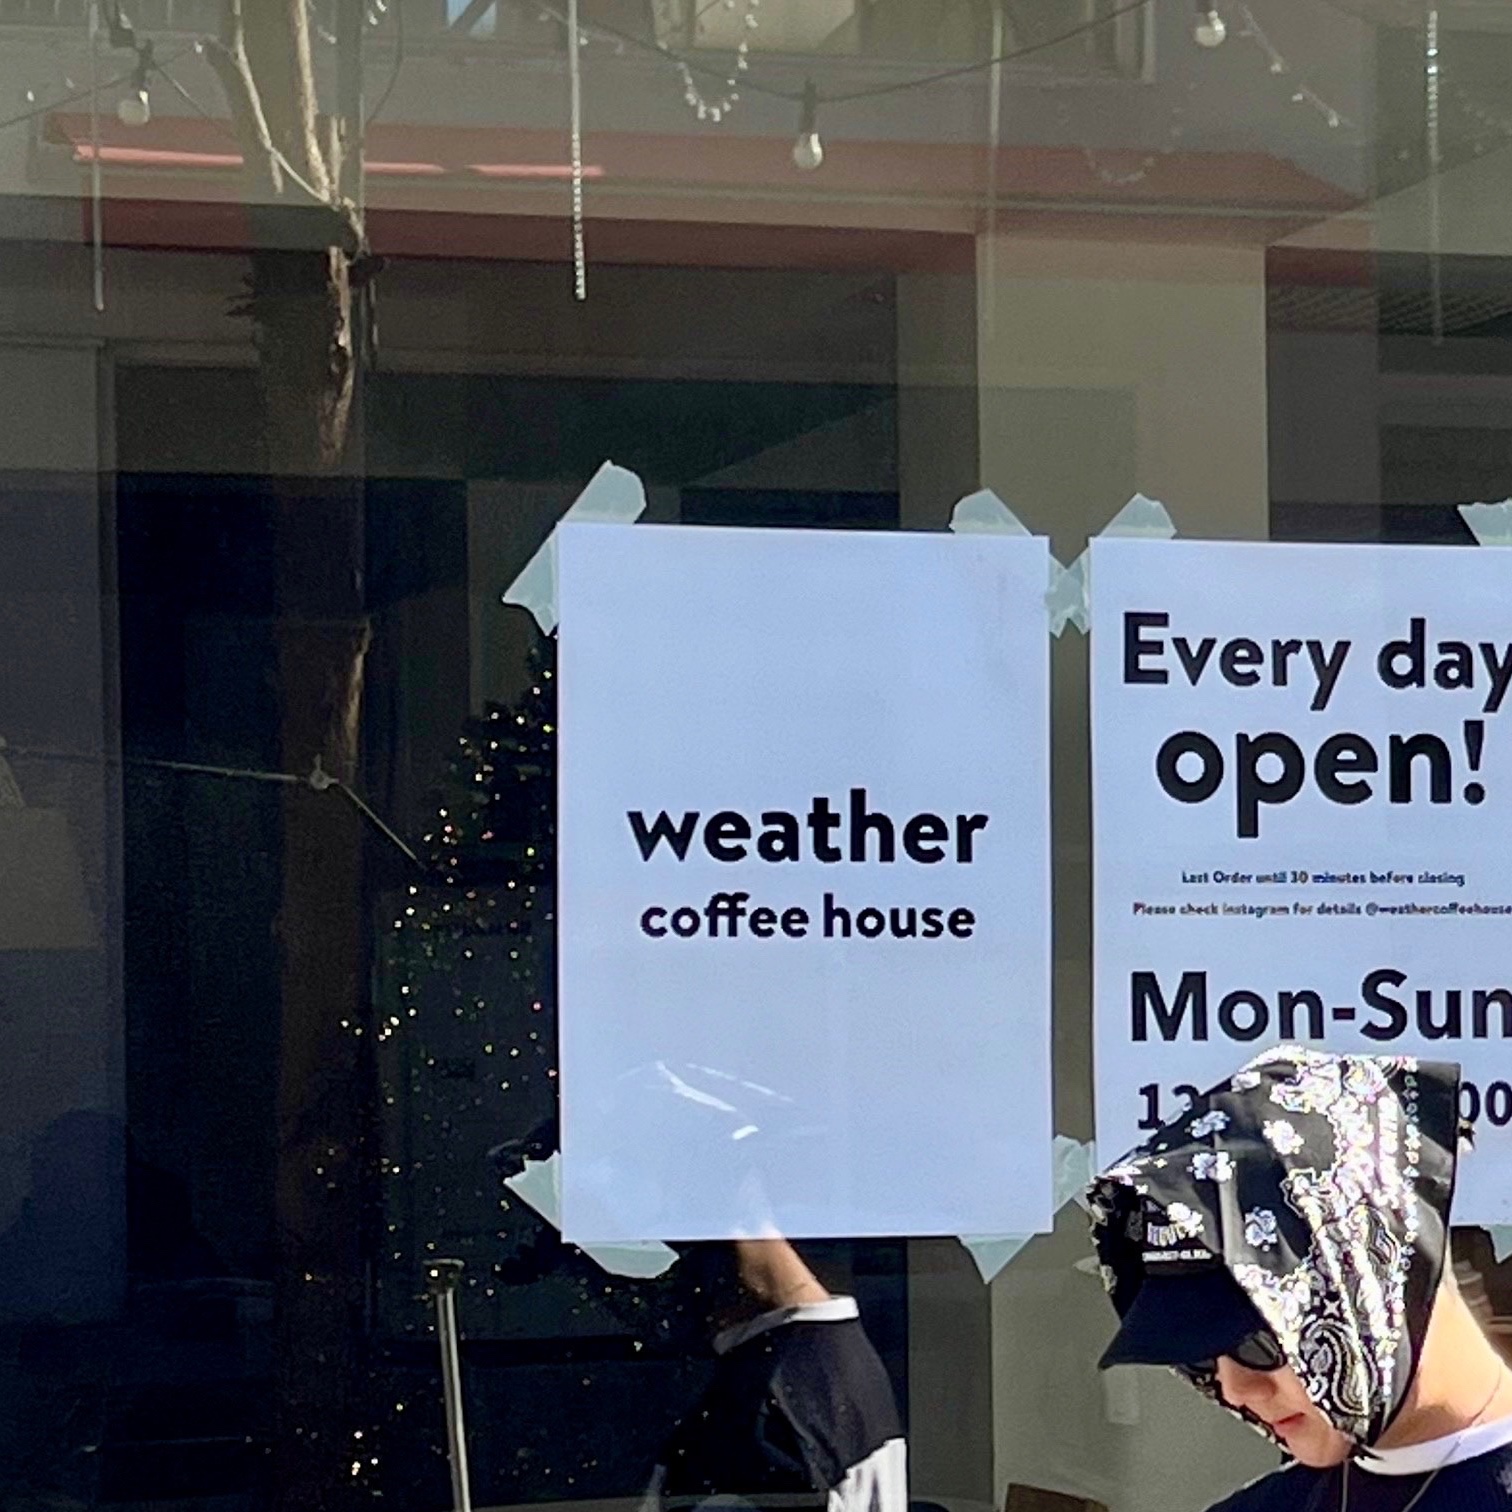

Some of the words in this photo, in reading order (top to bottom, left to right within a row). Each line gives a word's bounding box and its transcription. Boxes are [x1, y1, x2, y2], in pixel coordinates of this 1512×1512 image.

[1123, 611, 1352, 712] Every
[1155, 719, 1486, 839] open!
[626, 787, 989, 864] weather
[1132, 902, 1176, 916] Please
[1179, 902, 1219, 916] check
[1292, 902, 1314, 916] for
[1316, 902, 1362, 916] details
[1181, 871, 1210, 884] Last
[1212, 870, 1253, 884] Order
[1255, 871, 1288, 884] until
[1290, 870, 1309, 884] 30
[1311, 871, 1367, 884] minutes
[1369, 870, 1414, 884] before
[1417, 871, 1466, 887] closing
[640, 891, 810, 938] coffee
[823, 892, 976, 939] house
